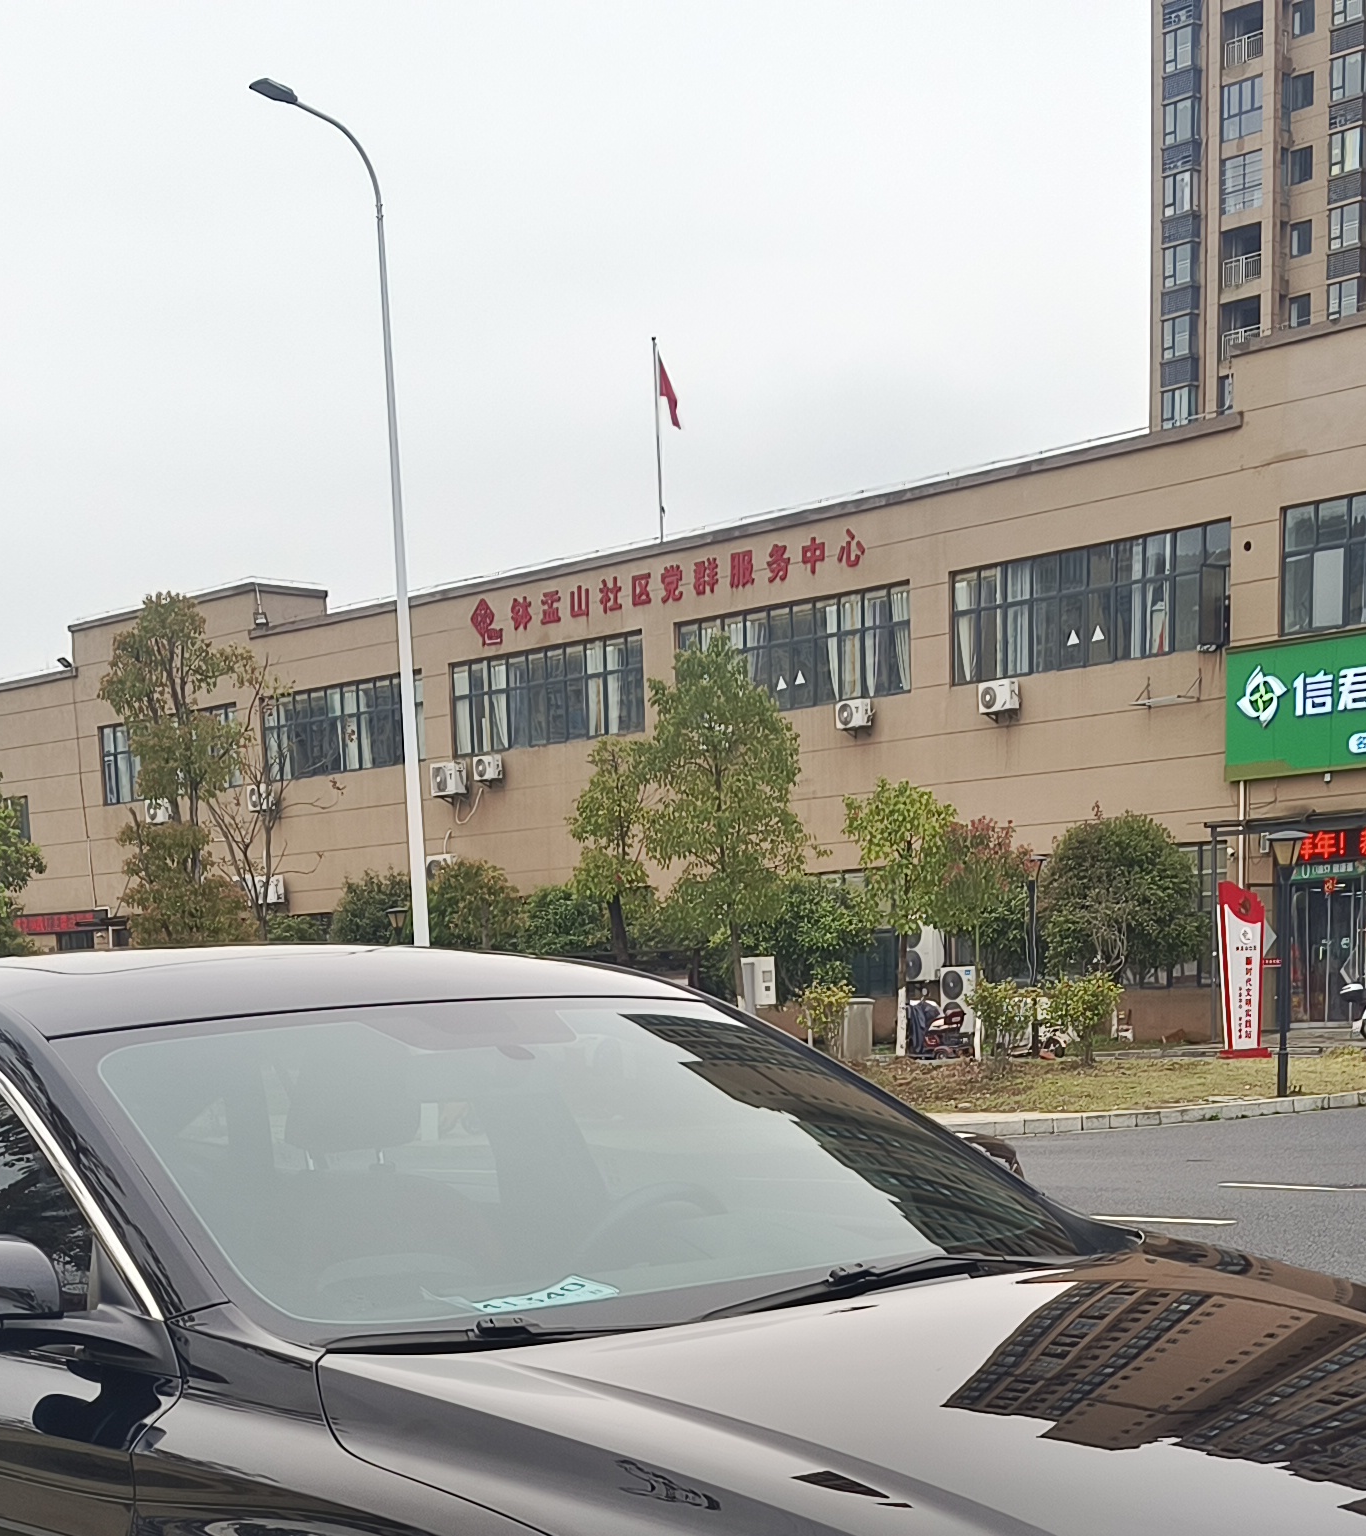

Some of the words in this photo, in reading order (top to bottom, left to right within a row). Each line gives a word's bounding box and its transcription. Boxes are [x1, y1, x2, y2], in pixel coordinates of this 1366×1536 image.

[510, 528, 866, 632] 钵盂山社区党群服务中心
